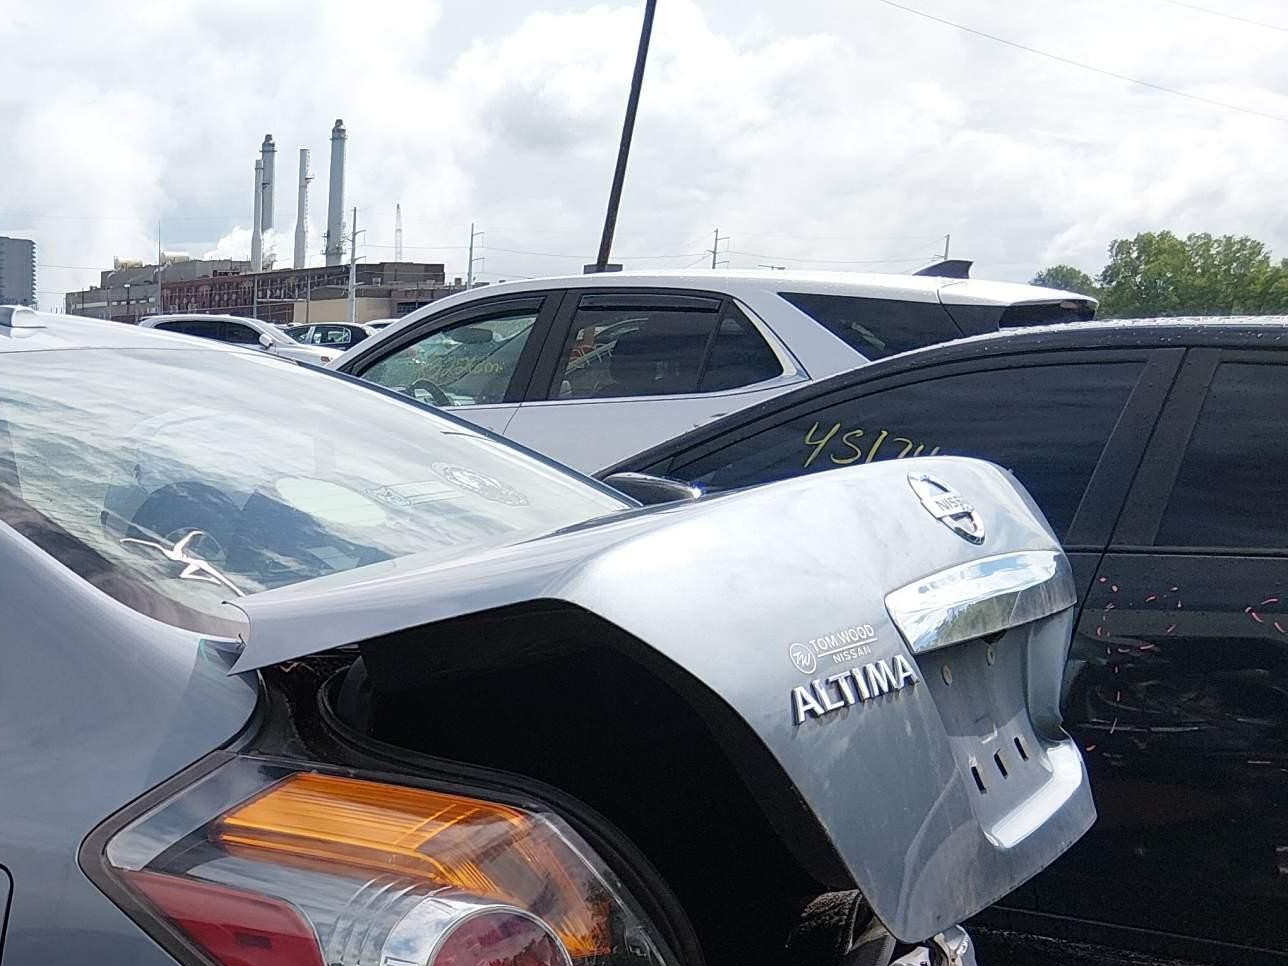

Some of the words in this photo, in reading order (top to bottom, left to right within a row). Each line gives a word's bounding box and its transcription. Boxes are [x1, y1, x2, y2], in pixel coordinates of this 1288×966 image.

[809, 634, 839, 652] TOM
[837, 624, 875, 643] WOOD
[832, 645, 872, 664] NISSAN
[791, 654, 920, 726] ALTIMA
